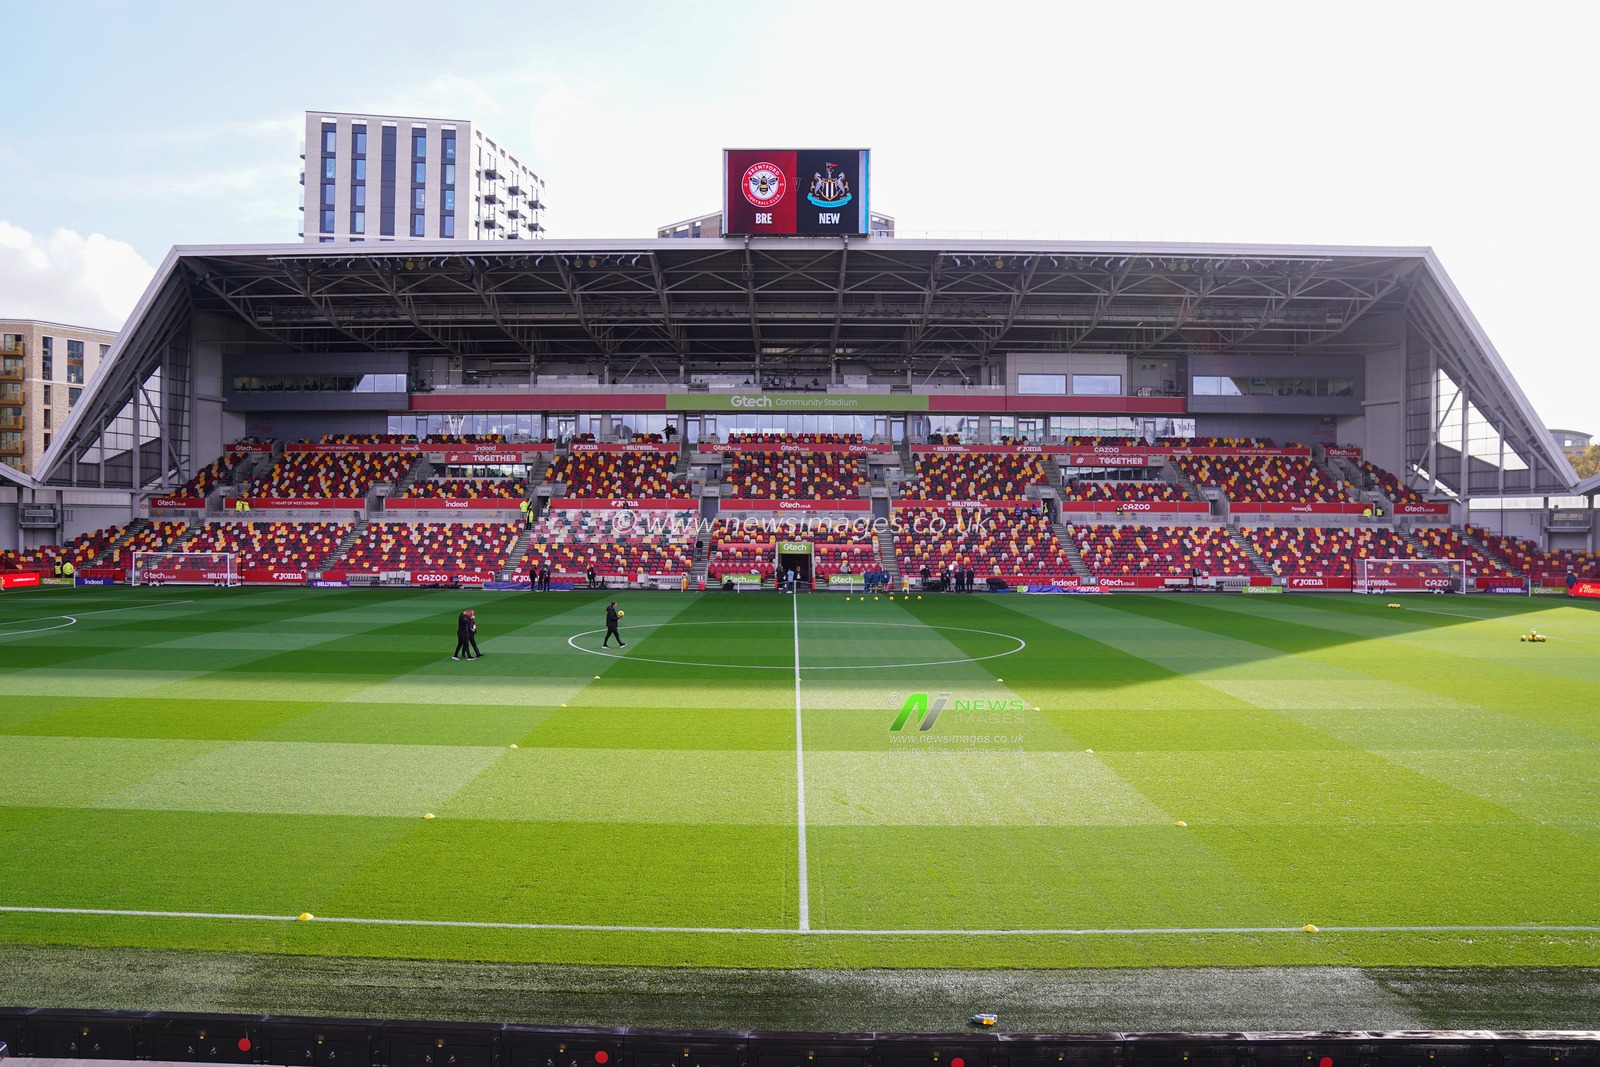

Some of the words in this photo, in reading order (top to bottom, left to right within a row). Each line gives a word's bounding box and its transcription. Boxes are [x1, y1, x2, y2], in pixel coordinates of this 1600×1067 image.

[748, 165, 780, 176] BRENTFORD
[756, 212, 772, 224] BRE
[818, 212, 840, 224] NEW
[731, 395, 772, 408] Gtech
[776, 398, 823, 408] Community
[824, 398, 858, 406] Stadium
